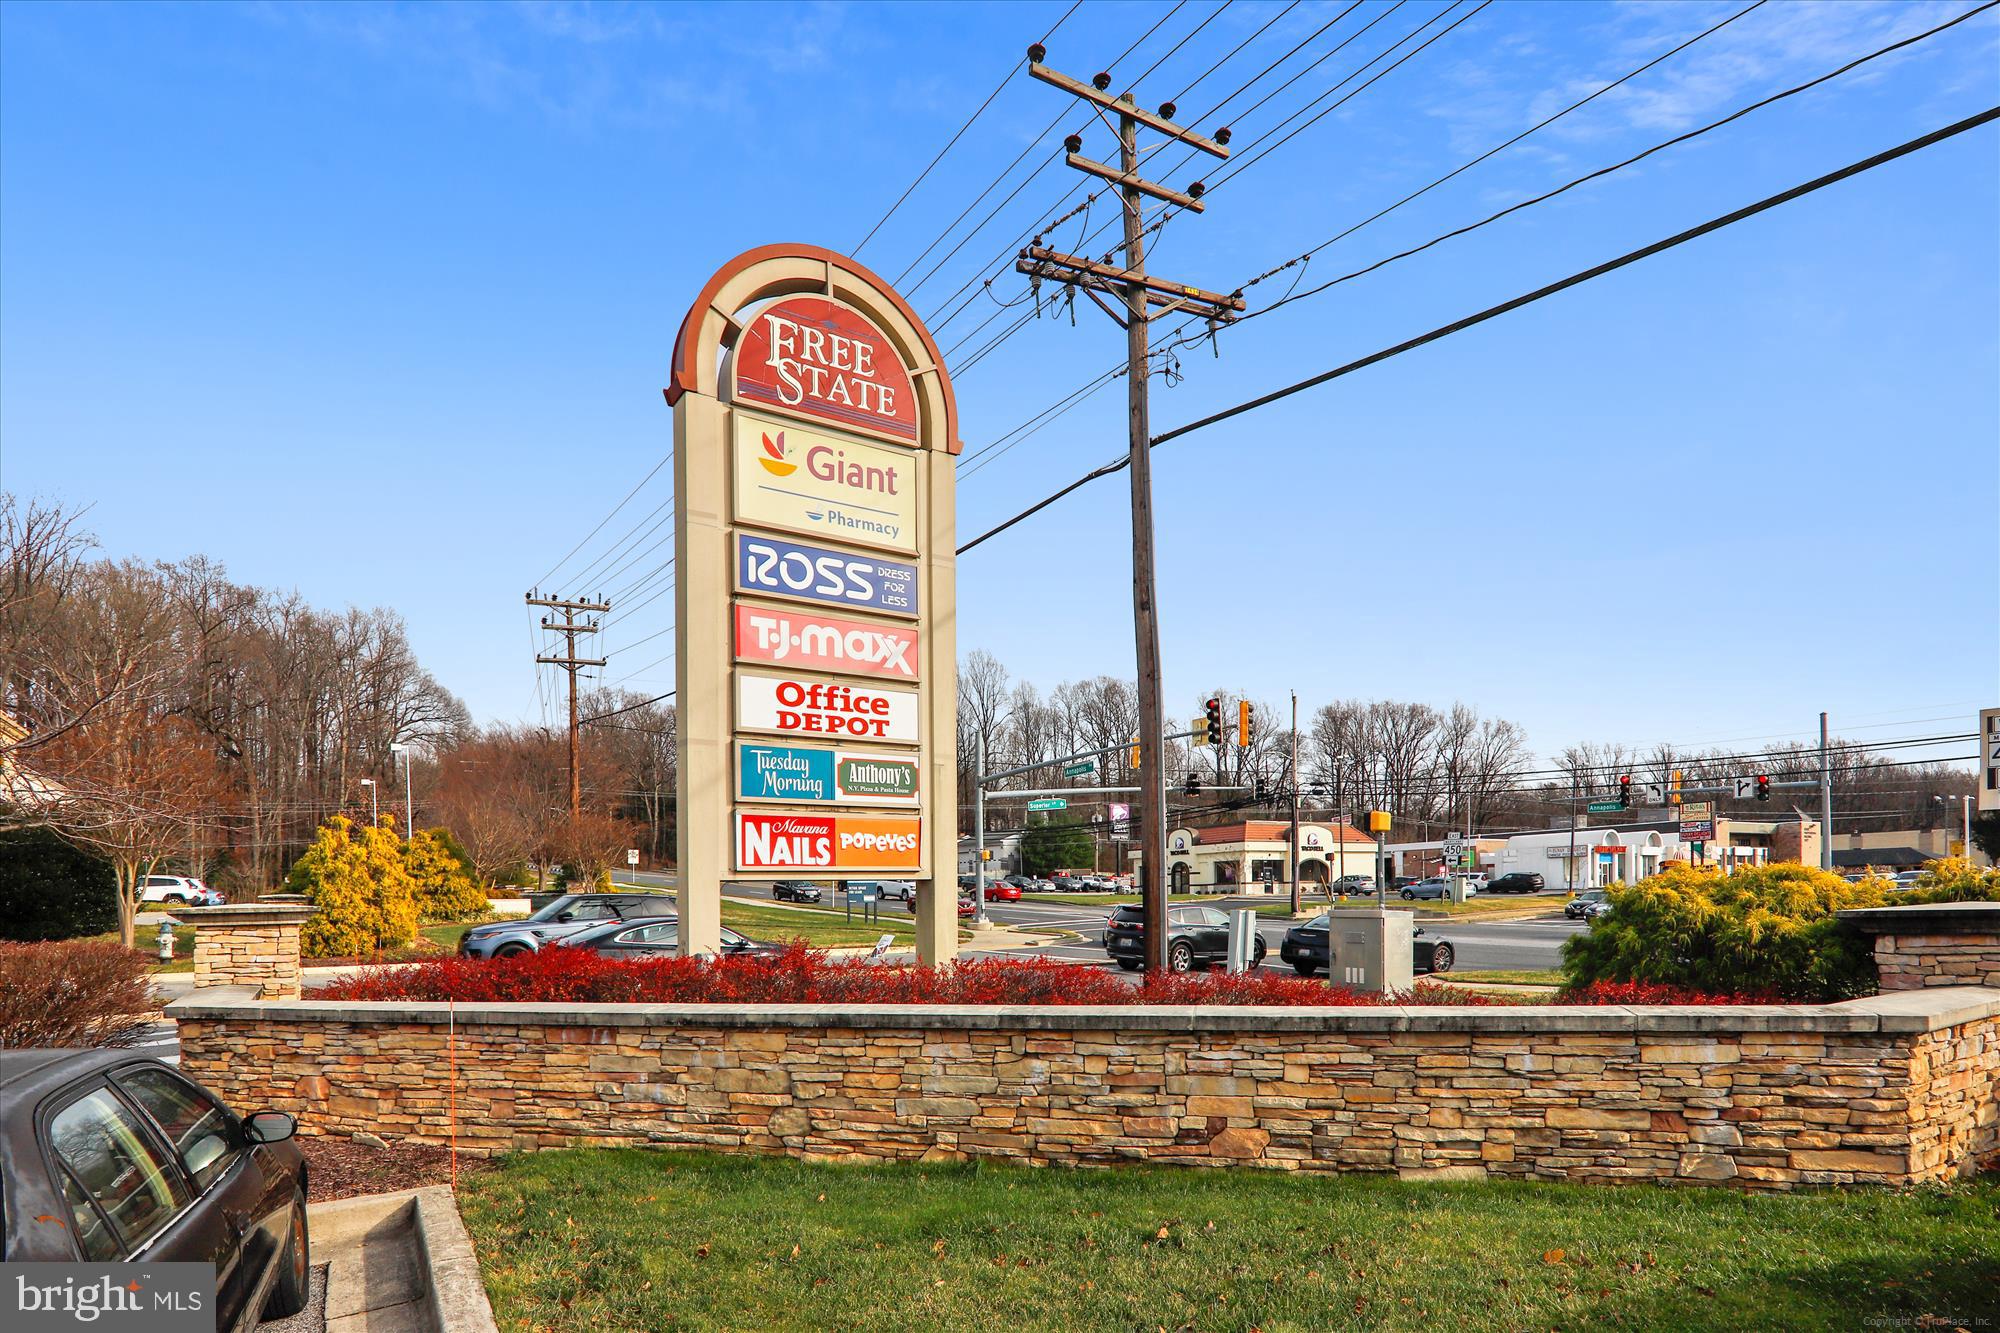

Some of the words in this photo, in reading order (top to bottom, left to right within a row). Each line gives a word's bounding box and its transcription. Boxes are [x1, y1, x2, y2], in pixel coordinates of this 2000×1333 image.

[764, 314, 875, 377] FREE
[776, 358, 896, 416] STATE
[806, 445, 898, 495] Giant
[828, 510, 899, 539] Pharmacy
[748, 544, 874, 600] ROSS
[878, 567, 911, 581] DRESS
[882, 595, 908, 607] LESS
[884, 582, 905, 593] FOR
[776, 681, 890, 715] Office
[776, 711, 890, 737] DEPOT
[751, 750, 809, 778] Tuesday
[849, 763, 911, 787] Anthony's
[762, 770, 823, 800] Morning
[745, 822, 831, 866] NAILS
[1444, 845, 1461, 855] 450
